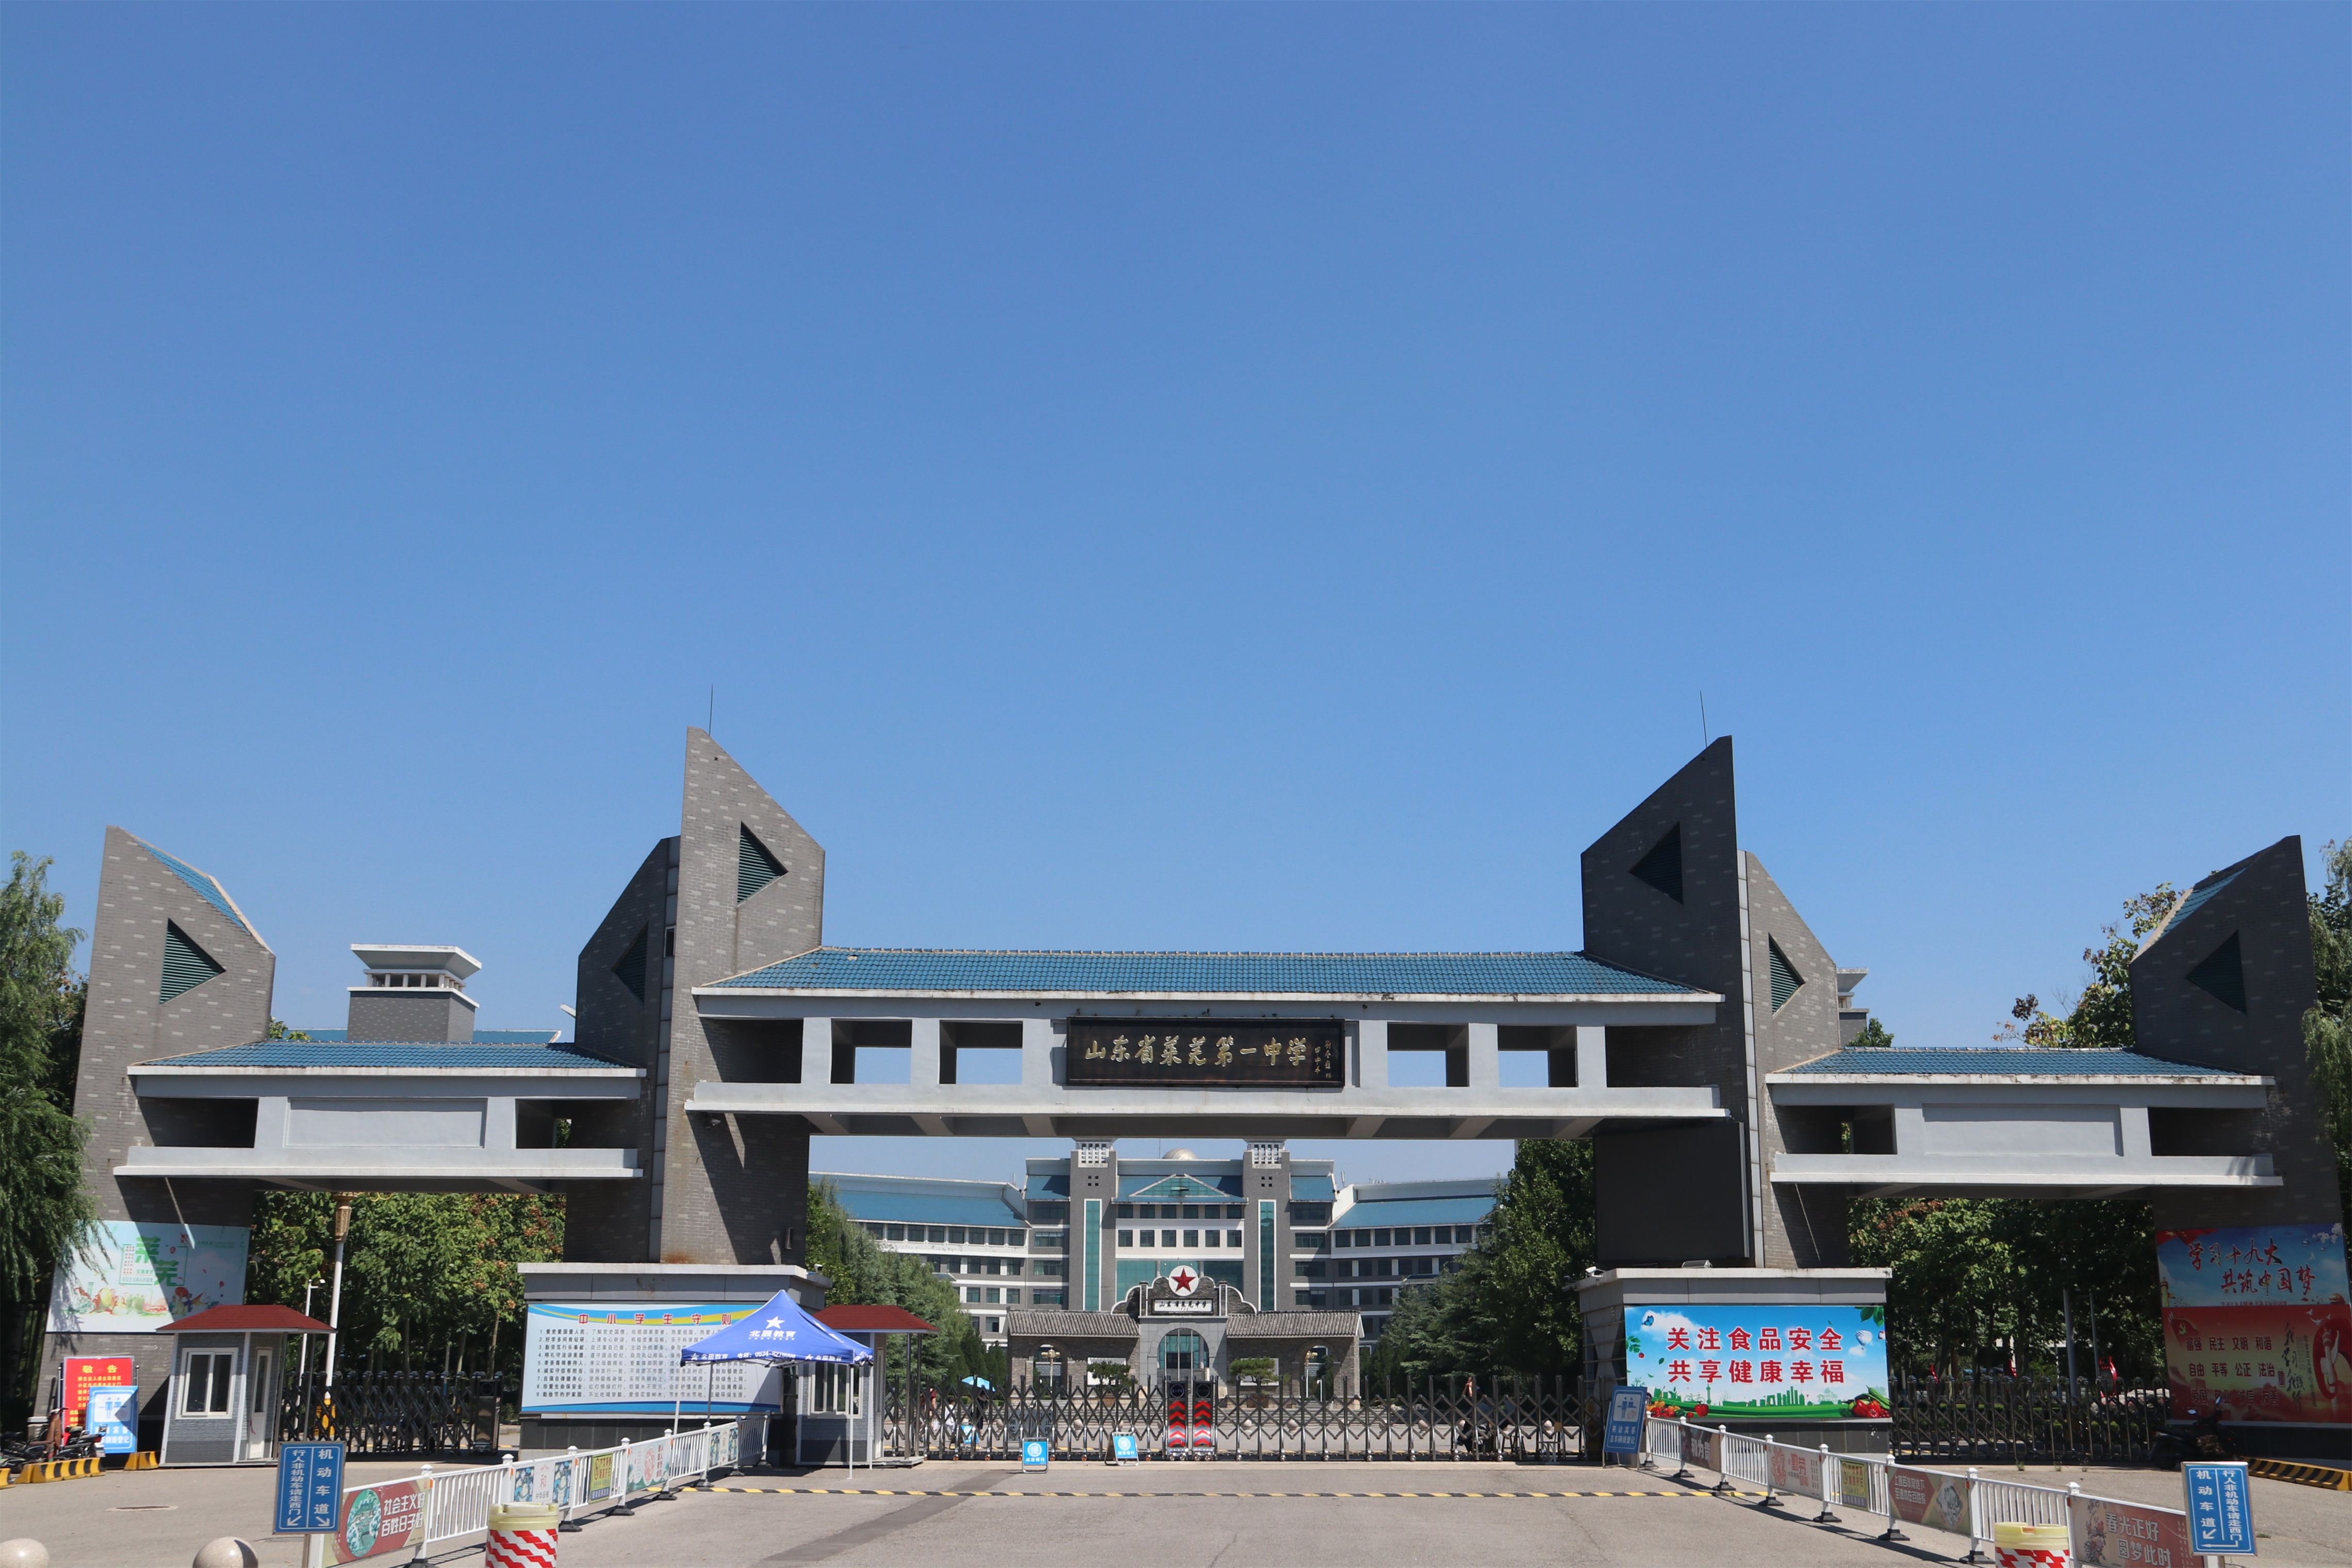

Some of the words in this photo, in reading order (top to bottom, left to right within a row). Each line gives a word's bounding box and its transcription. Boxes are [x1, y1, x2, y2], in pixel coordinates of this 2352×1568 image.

[1085, 1034, 1306, 1067] 山东省莱芜第一中学
[2188, 1238, 2283, 1271] 学习十九大
[2220, 1264, 2316, 1296] 共筑中国梦
[579, 1314, 731, 1325] 中小学生守则
[1667, 1326, 1842, 1351] 关注食品安全
[2186, 1337, 2202, 1351] 富强
[2209, 1337, 2225, 1351] 民主
[2232, 1336, 2248, 1350] 文明
[2255, 1336, 2272, 1350] 和谐
[1668, 1359, 1844, 1383] 共享健康幸福
[2189, 1363, 2204, 1377] 自由
[2212, 1362, 2228, 1377] 平等
[2235, 1363, 2251, 1377] 公正
[2258, 1362, 2275, 1377] 法治
[2191, 1390, 2207, 1403] 爱国
[2237, 1390, 2254, 1403] 诚信
[2261, 1390, 2278, 1404] 友善
[288, 1449, 306, 1515] 行人非机动车请走西门
[314, 1449, 334, 1514] 机动车道
[383, 1492, 426, 1516] 社会主义好
[2196, 1470, 2216, 1527] 机动车道
[2222, 1470, 2243, 1541] 行人非机动车请走西门
[381, 1512, 424, 1538] 百姓日子好
[2105, 1511, 2159, 1542] 春光正好
[2116, 1538, 2171, 1568] 圆梦此时
